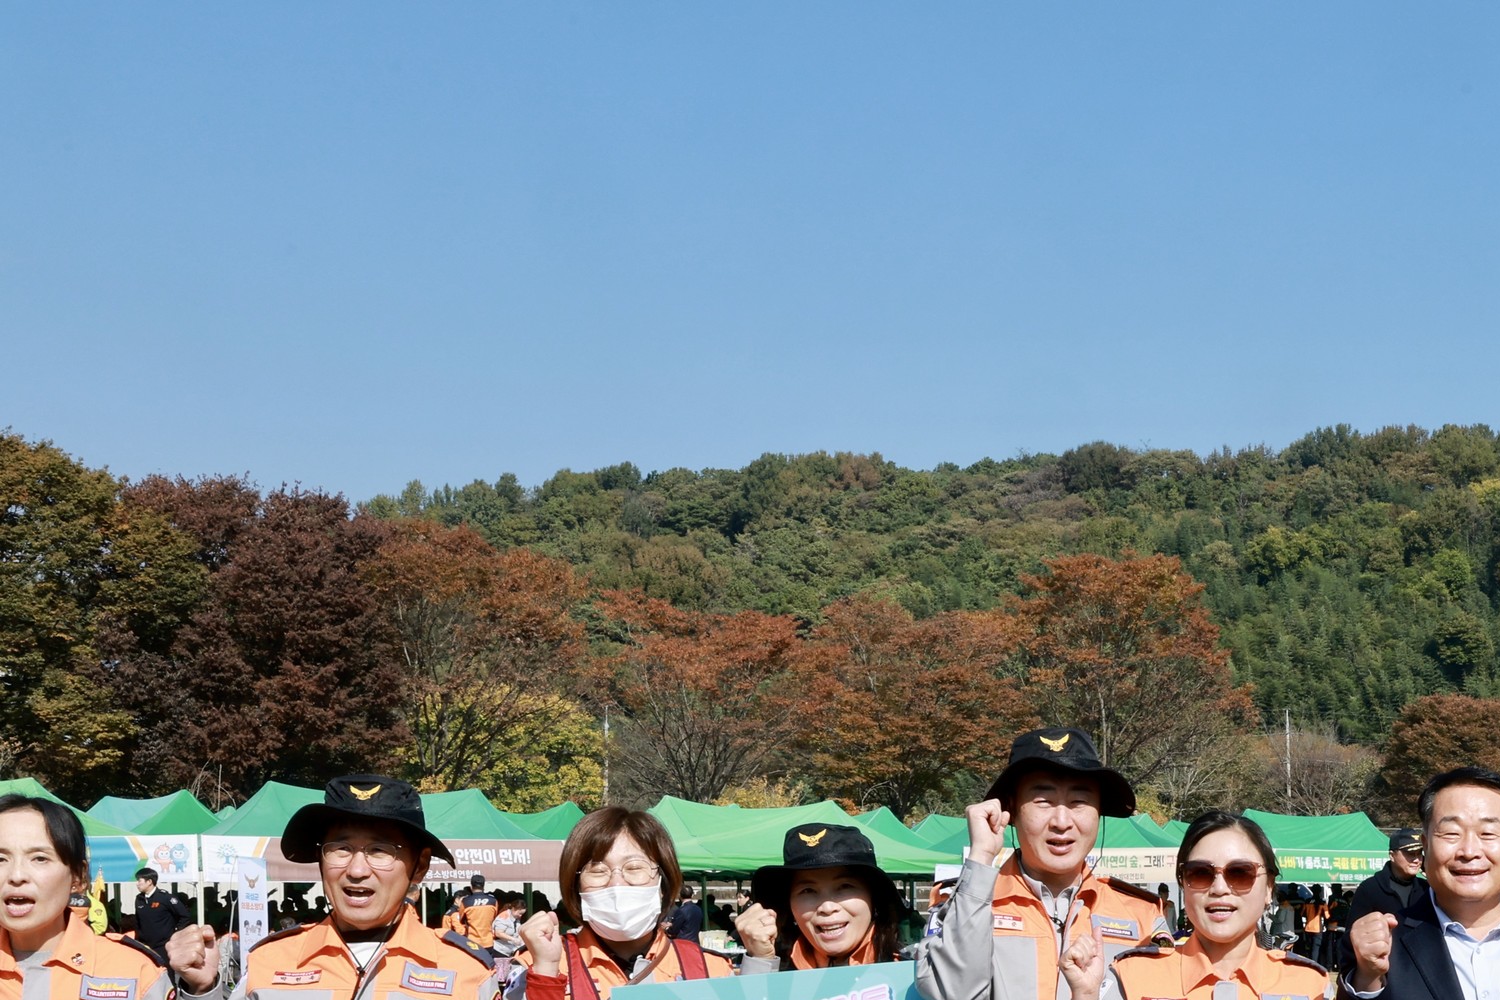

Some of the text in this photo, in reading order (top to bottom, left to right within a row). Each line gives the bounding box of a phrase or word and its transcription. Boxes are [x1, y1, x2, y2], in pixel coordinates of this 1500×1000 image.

[455, 848, 497, 864] 안전이
[500, 848, 531, 864] 먼저!
[1144, 855, 1165, 868] 그래!
